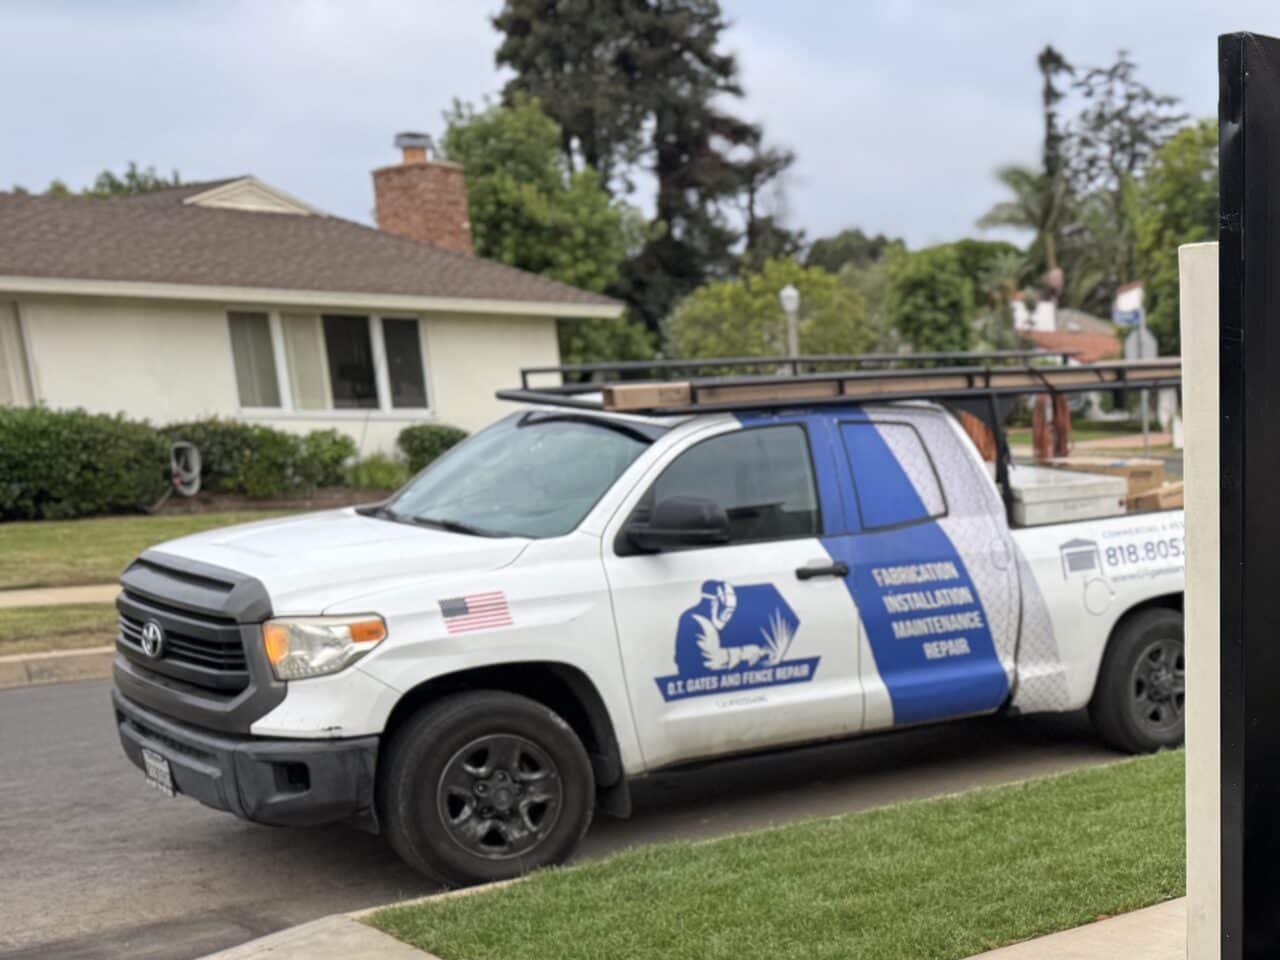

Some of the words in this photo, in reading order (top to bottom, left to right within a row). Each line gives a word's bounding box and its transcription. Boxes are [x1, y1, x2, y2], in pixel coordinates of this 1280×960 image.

[871, 560, 960, 587] FABRICATION
[882, 586, 975, 614] INSTALLATION
[891, 610, 984, 640] MAINTENANCE
[922, 637, 971, 660] REPAIR
[686, 676, 718, 692] GATES
[720, 673, 741, 688] AND
[743, 669, 773, 685] FENCE
[775, 664, 810, 680] REPAIR
